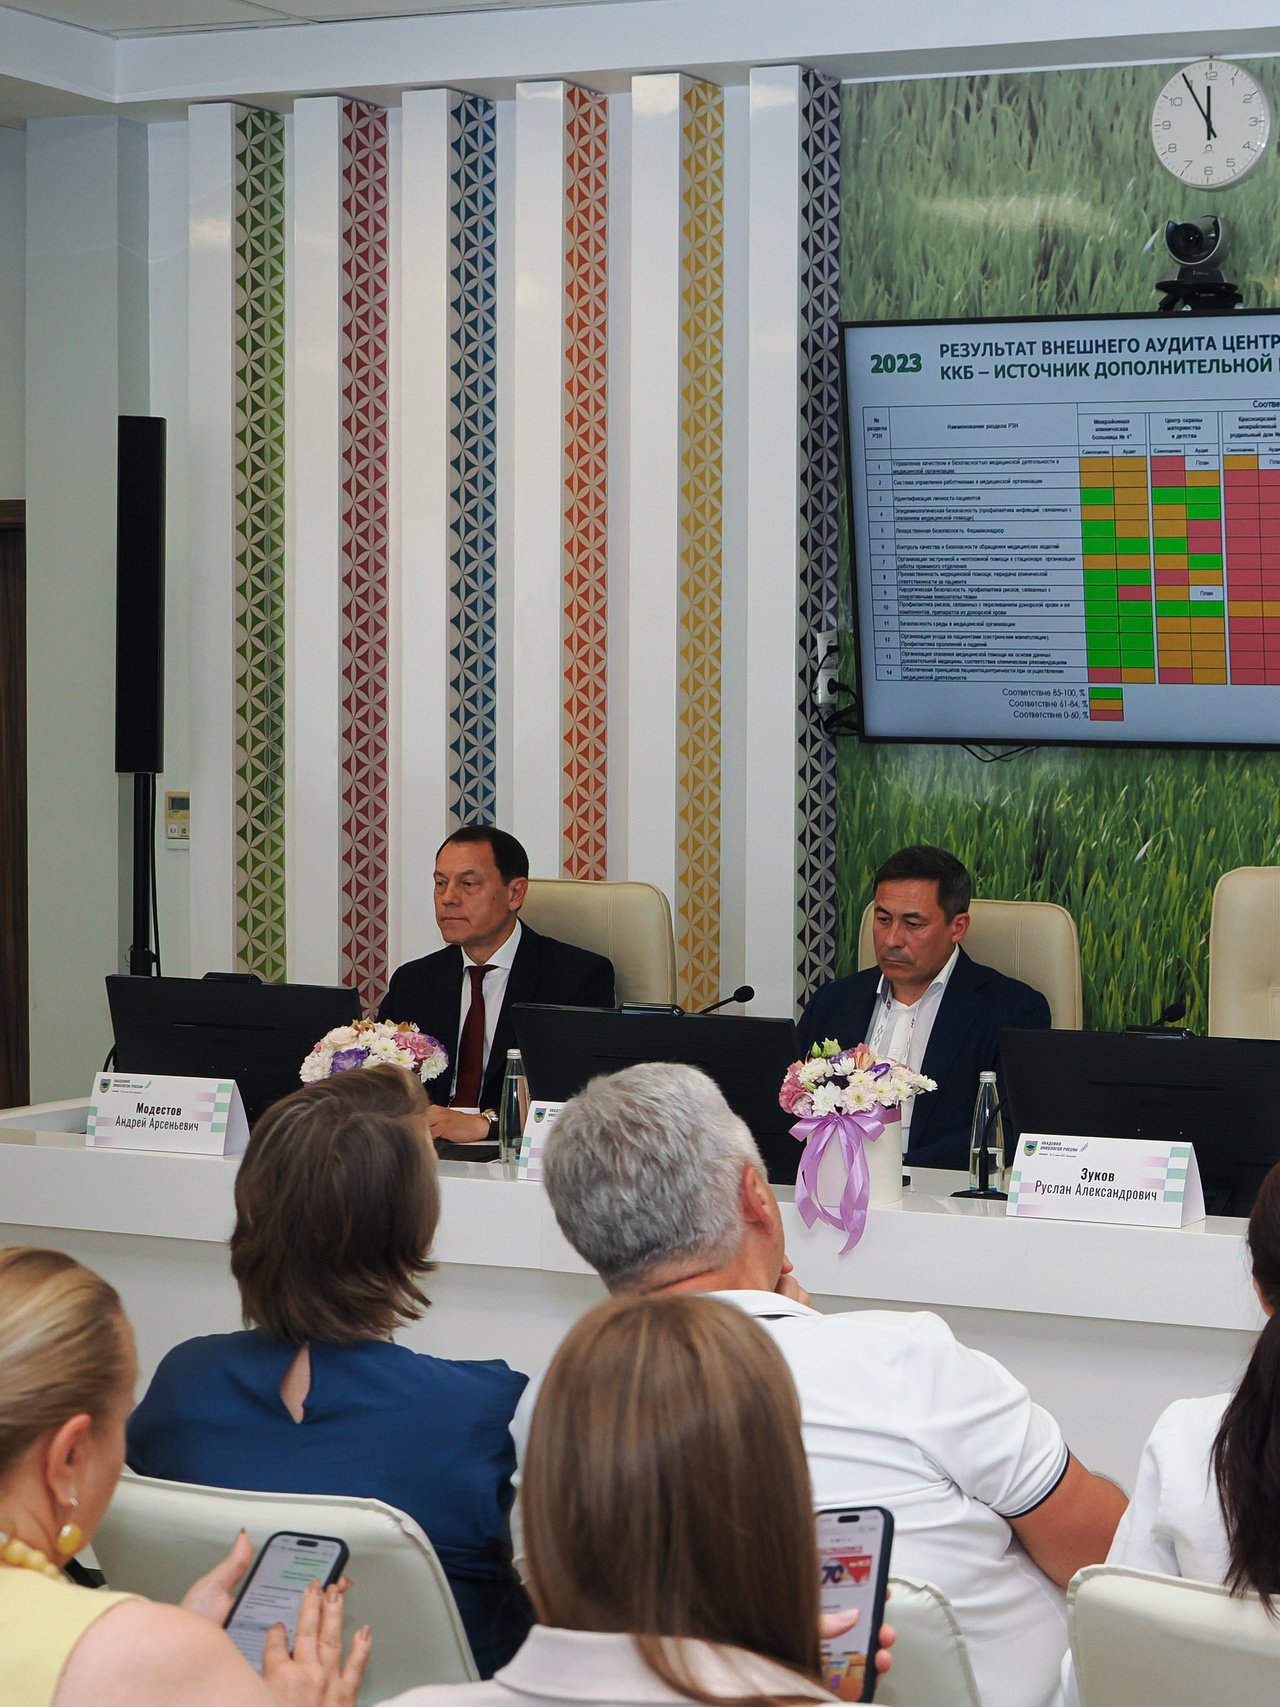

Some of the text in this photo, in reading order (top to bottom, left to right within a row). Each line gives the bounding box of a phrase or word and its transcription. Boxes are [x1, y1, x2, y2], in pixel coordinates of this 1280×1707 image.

[1204, 71, 1218, 81] 12
[1169, 97, 1182, 107] 10
[1243, 94, 1252, 103] 2
[1162, 120, 1171, 130] 9
[1249, 117, 1258, 127] 3
[1168, 143, 1177, 153] 8
[1242, 141, 1251, 150] 4
[1184, 160, 1193, 169] 7
[1226, 158, 1235, 167] 5
[1204, 166, 1213, 175] 6
[939, 341, 1036, 358] РЕЗУЛЬТАТ
[1042, 338, 1139, 356] ВНЕШНЕГО
[1145, 336, 1217, 354] АУДИТА
[870, 353, 922, 374] 2023
[940, 365, 974, 380] ККБ
[994, 362, 1090, 379] ИСТОЧНИК
[1094, 354, 1273, 380] ДОПОЛНИТЕЛЬНОЙ
[1002, 688, 1086, 697] Соответствие 85-100, %
[1008, 699, 1089, 709] Соответствие 61-84, %
[1013, 710, 1089, 719] Соответствие 0-60, %
[136, 1102, 182, 1116] Модестов
[115, 1115, 199, 1131] Андрей Арсеньевич
[1080, 1167, 1115, 1183] Зуков
[1034, 1180, 1157, 1201] Руслан Александрович
